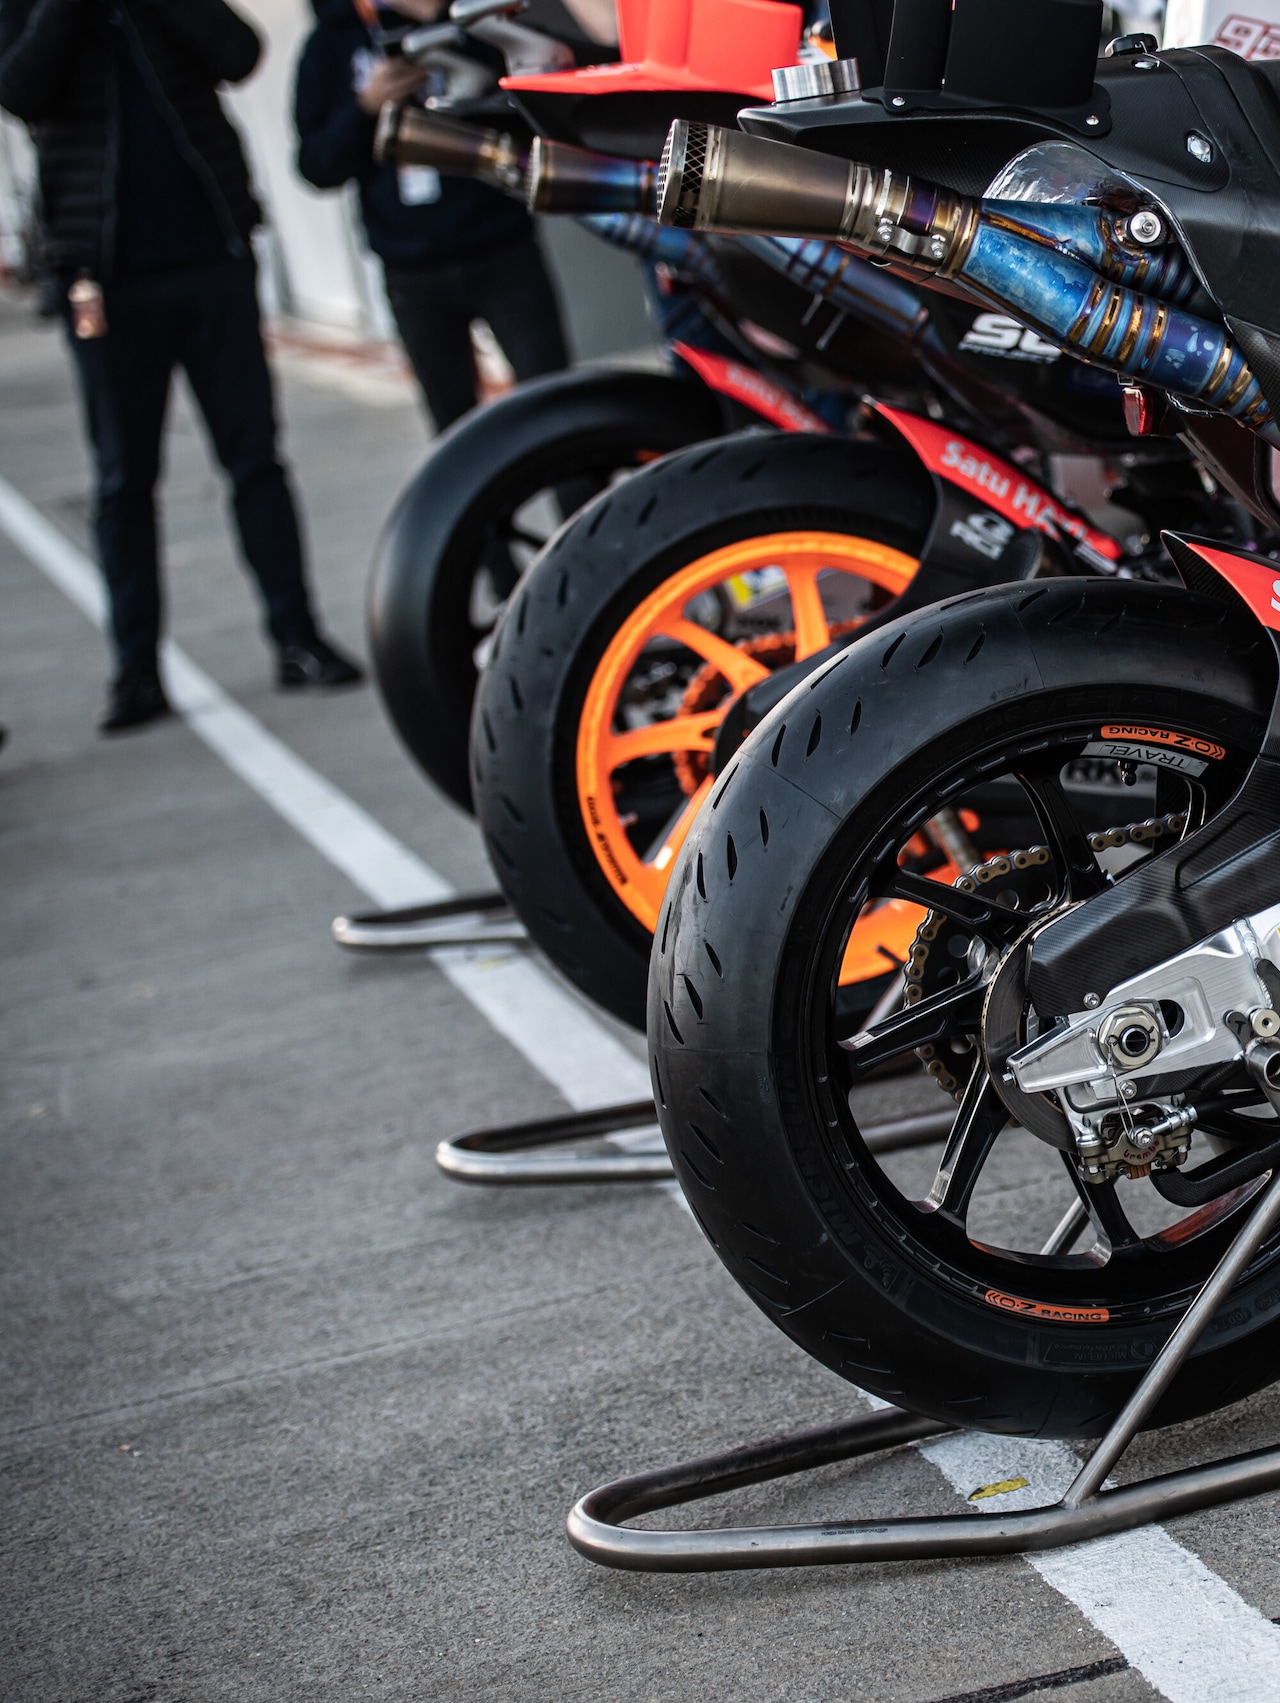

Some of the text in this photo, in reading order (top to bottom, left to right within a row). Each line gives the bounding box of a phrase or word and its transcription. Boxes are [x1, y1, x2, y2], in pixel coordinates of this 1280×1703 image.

[1108, 726, 1170, 740] RACING
[1104, 743, 1186, 770] TRAVEL
[1123, 1139, 1160, 1161] brembo
[1041, 1308, 1102, 1321] RACING
